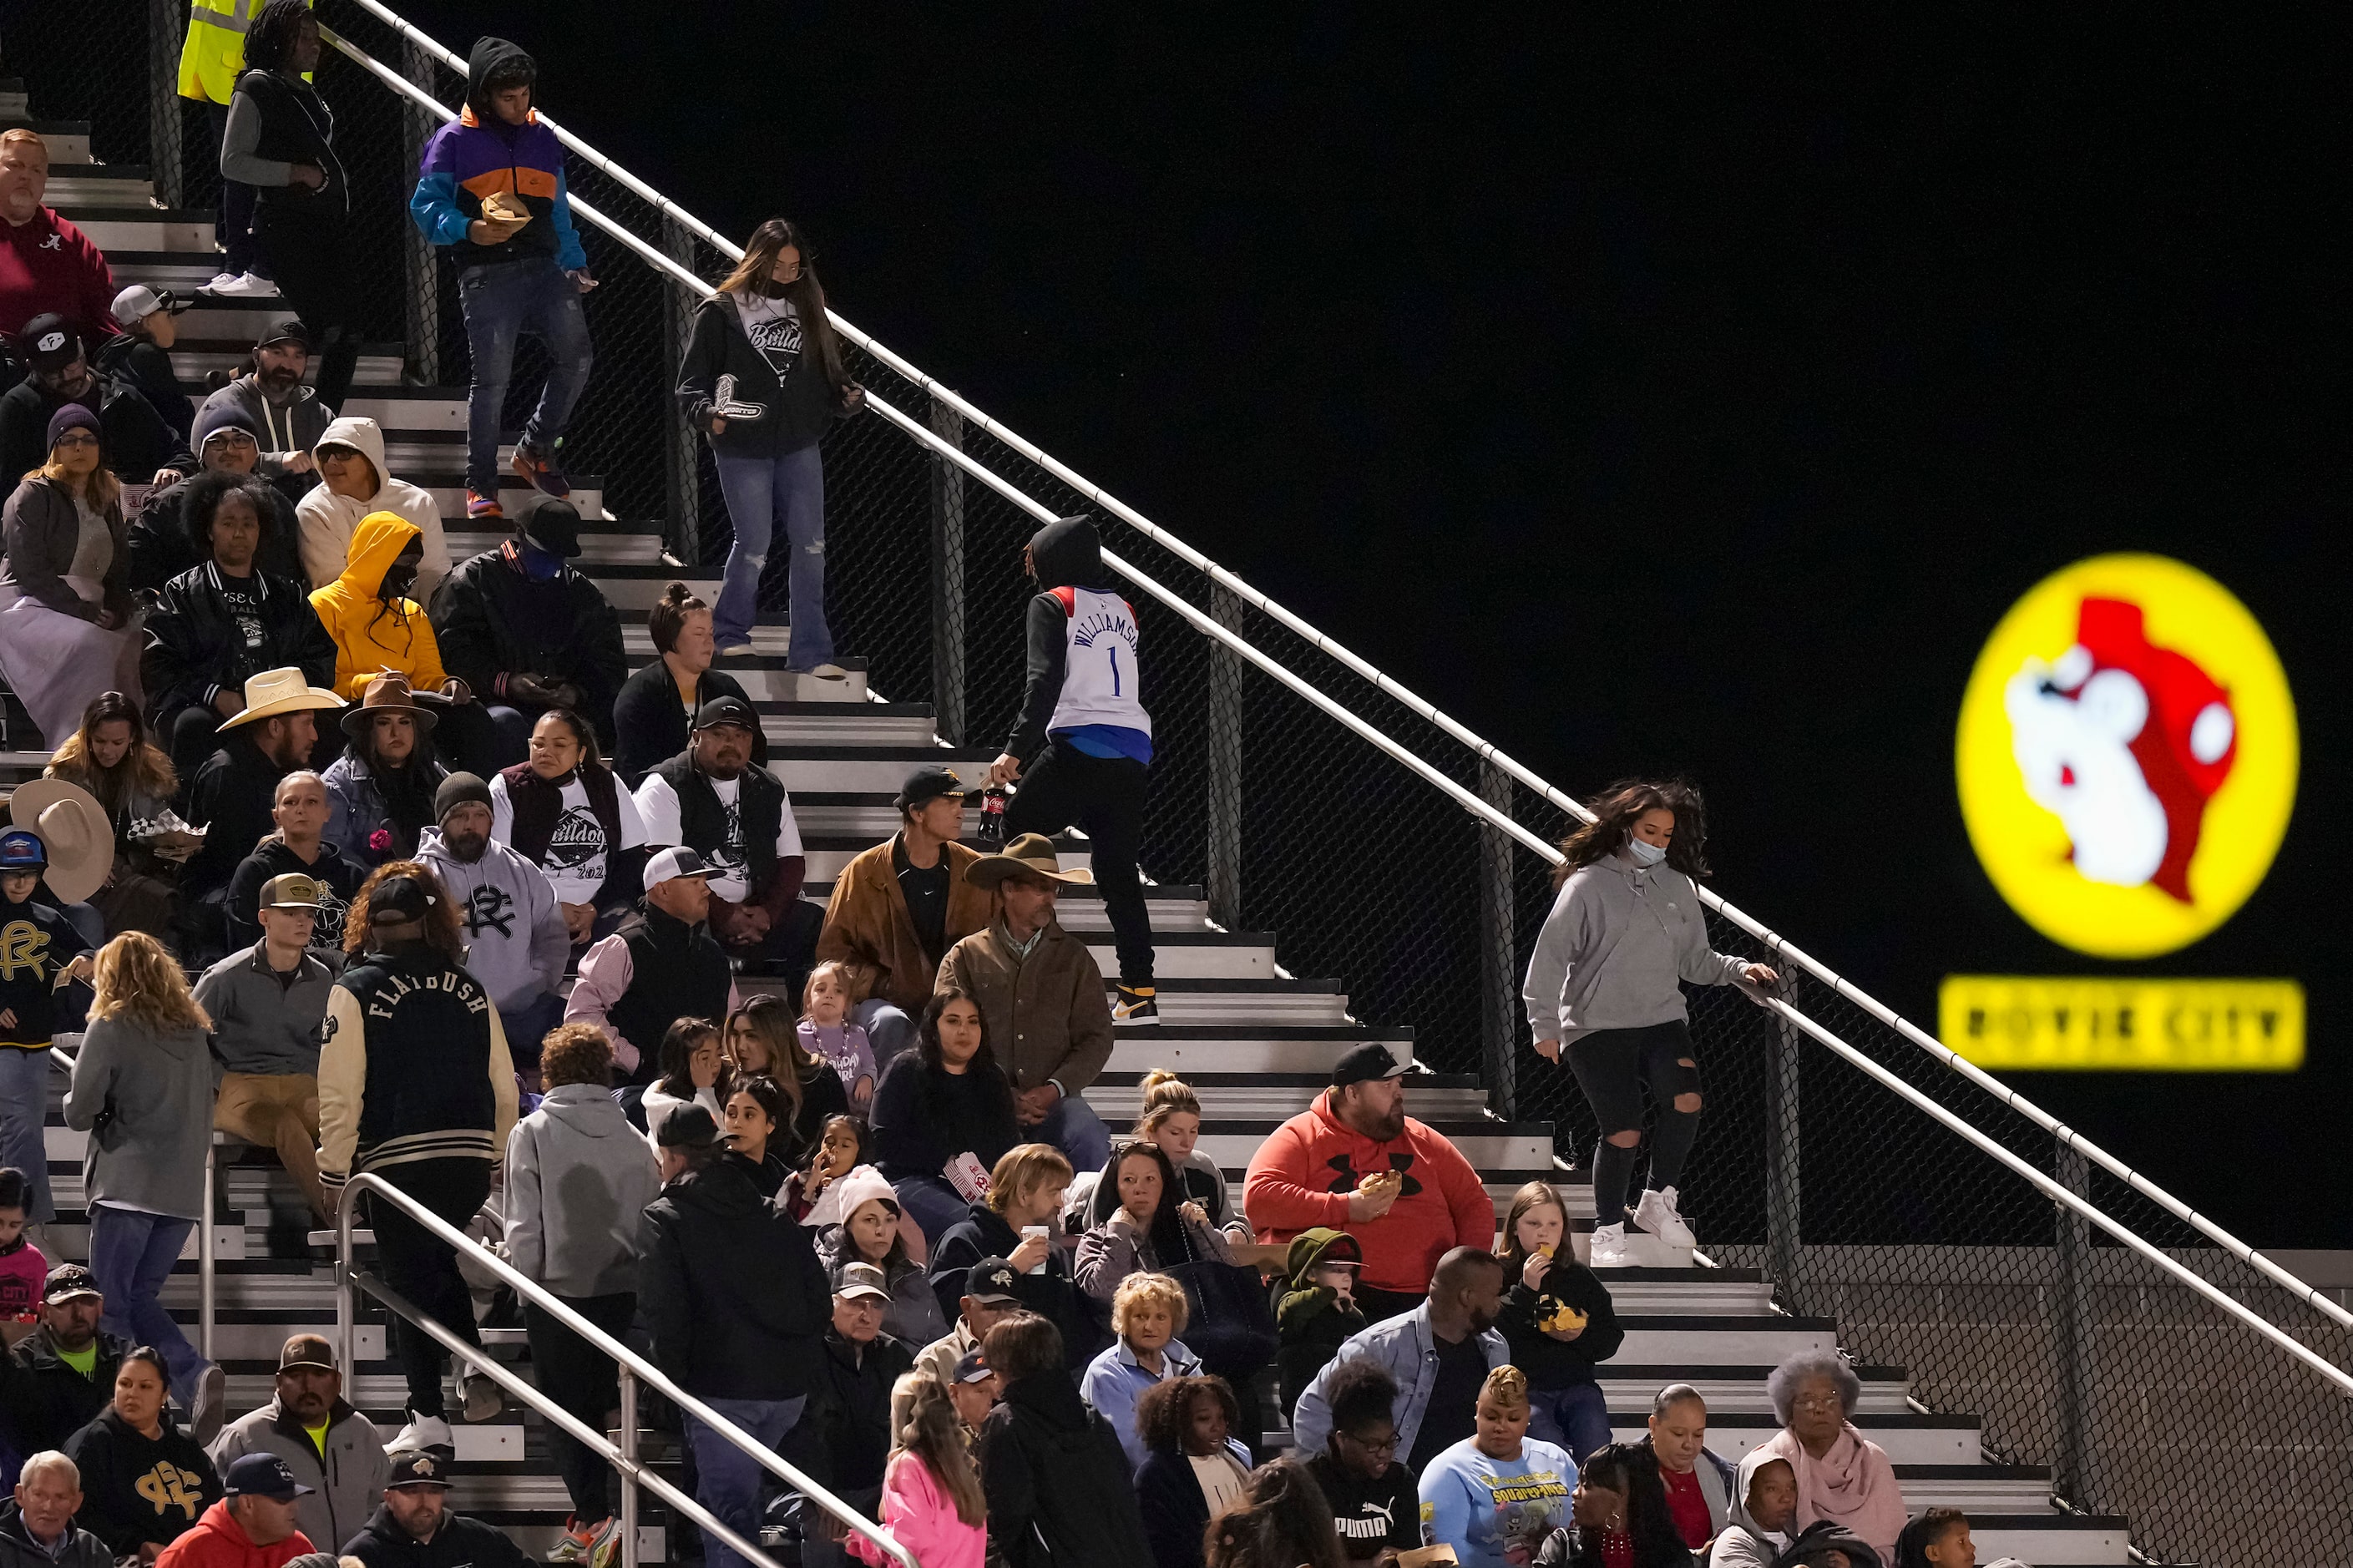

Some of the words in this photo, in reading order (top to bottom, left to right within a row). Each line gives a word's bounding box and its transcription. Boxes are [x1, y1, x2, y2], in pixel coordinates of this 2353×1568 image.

[750, 322, 803, 351] Bulld
[1107, 646, 1122, 697] 1
[550, 823, 605, 852] ulldog
[577, 865, 604, 879] 202
[1334, 1516, 1387, 1538] PUMA
